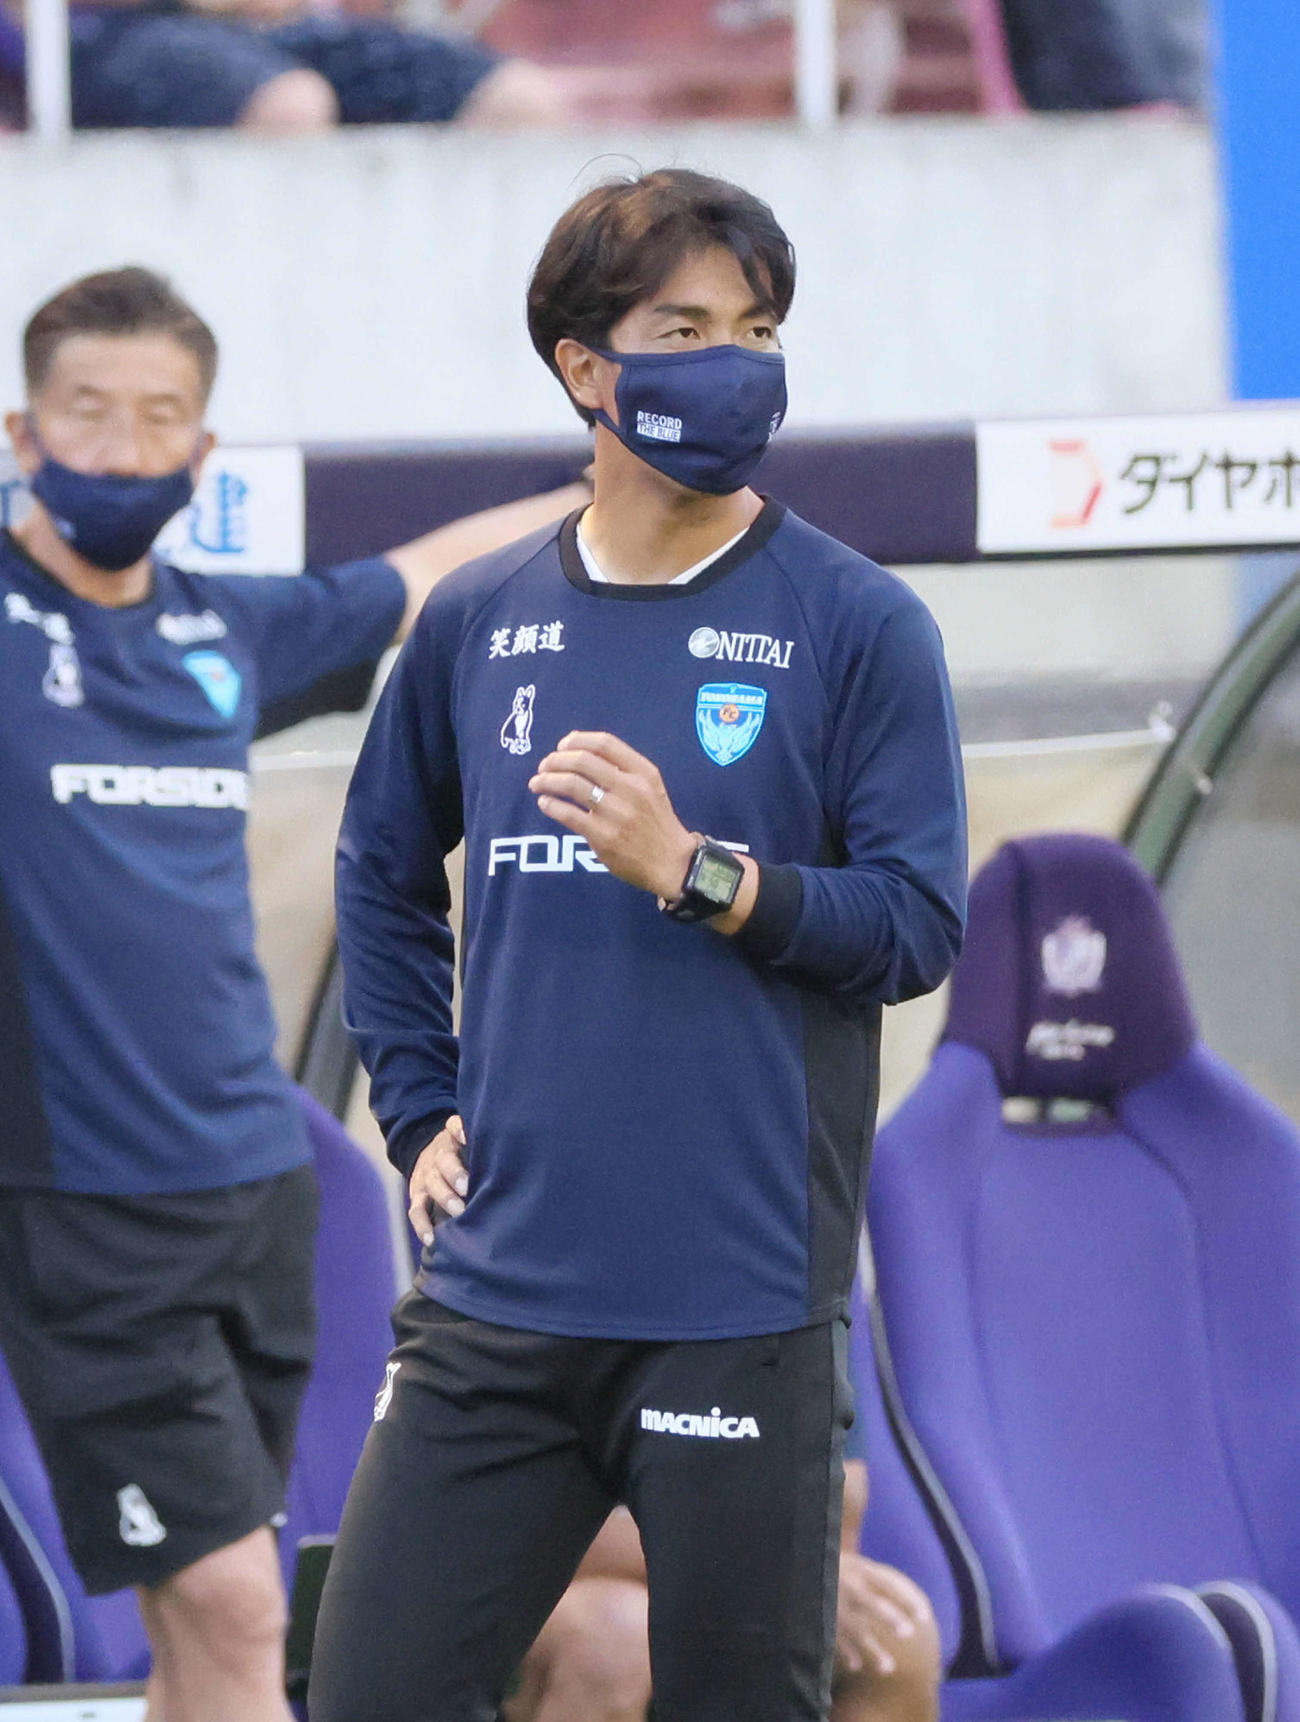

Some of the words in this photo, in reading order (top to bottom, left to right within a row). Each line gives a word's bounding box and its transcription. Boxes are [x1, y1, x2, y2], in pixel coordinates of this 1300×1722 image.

[637, 410, 682, 429] RECORD
[637, 423, 655, 436] THE
[488, 620, 565, 659] 笑顔道
